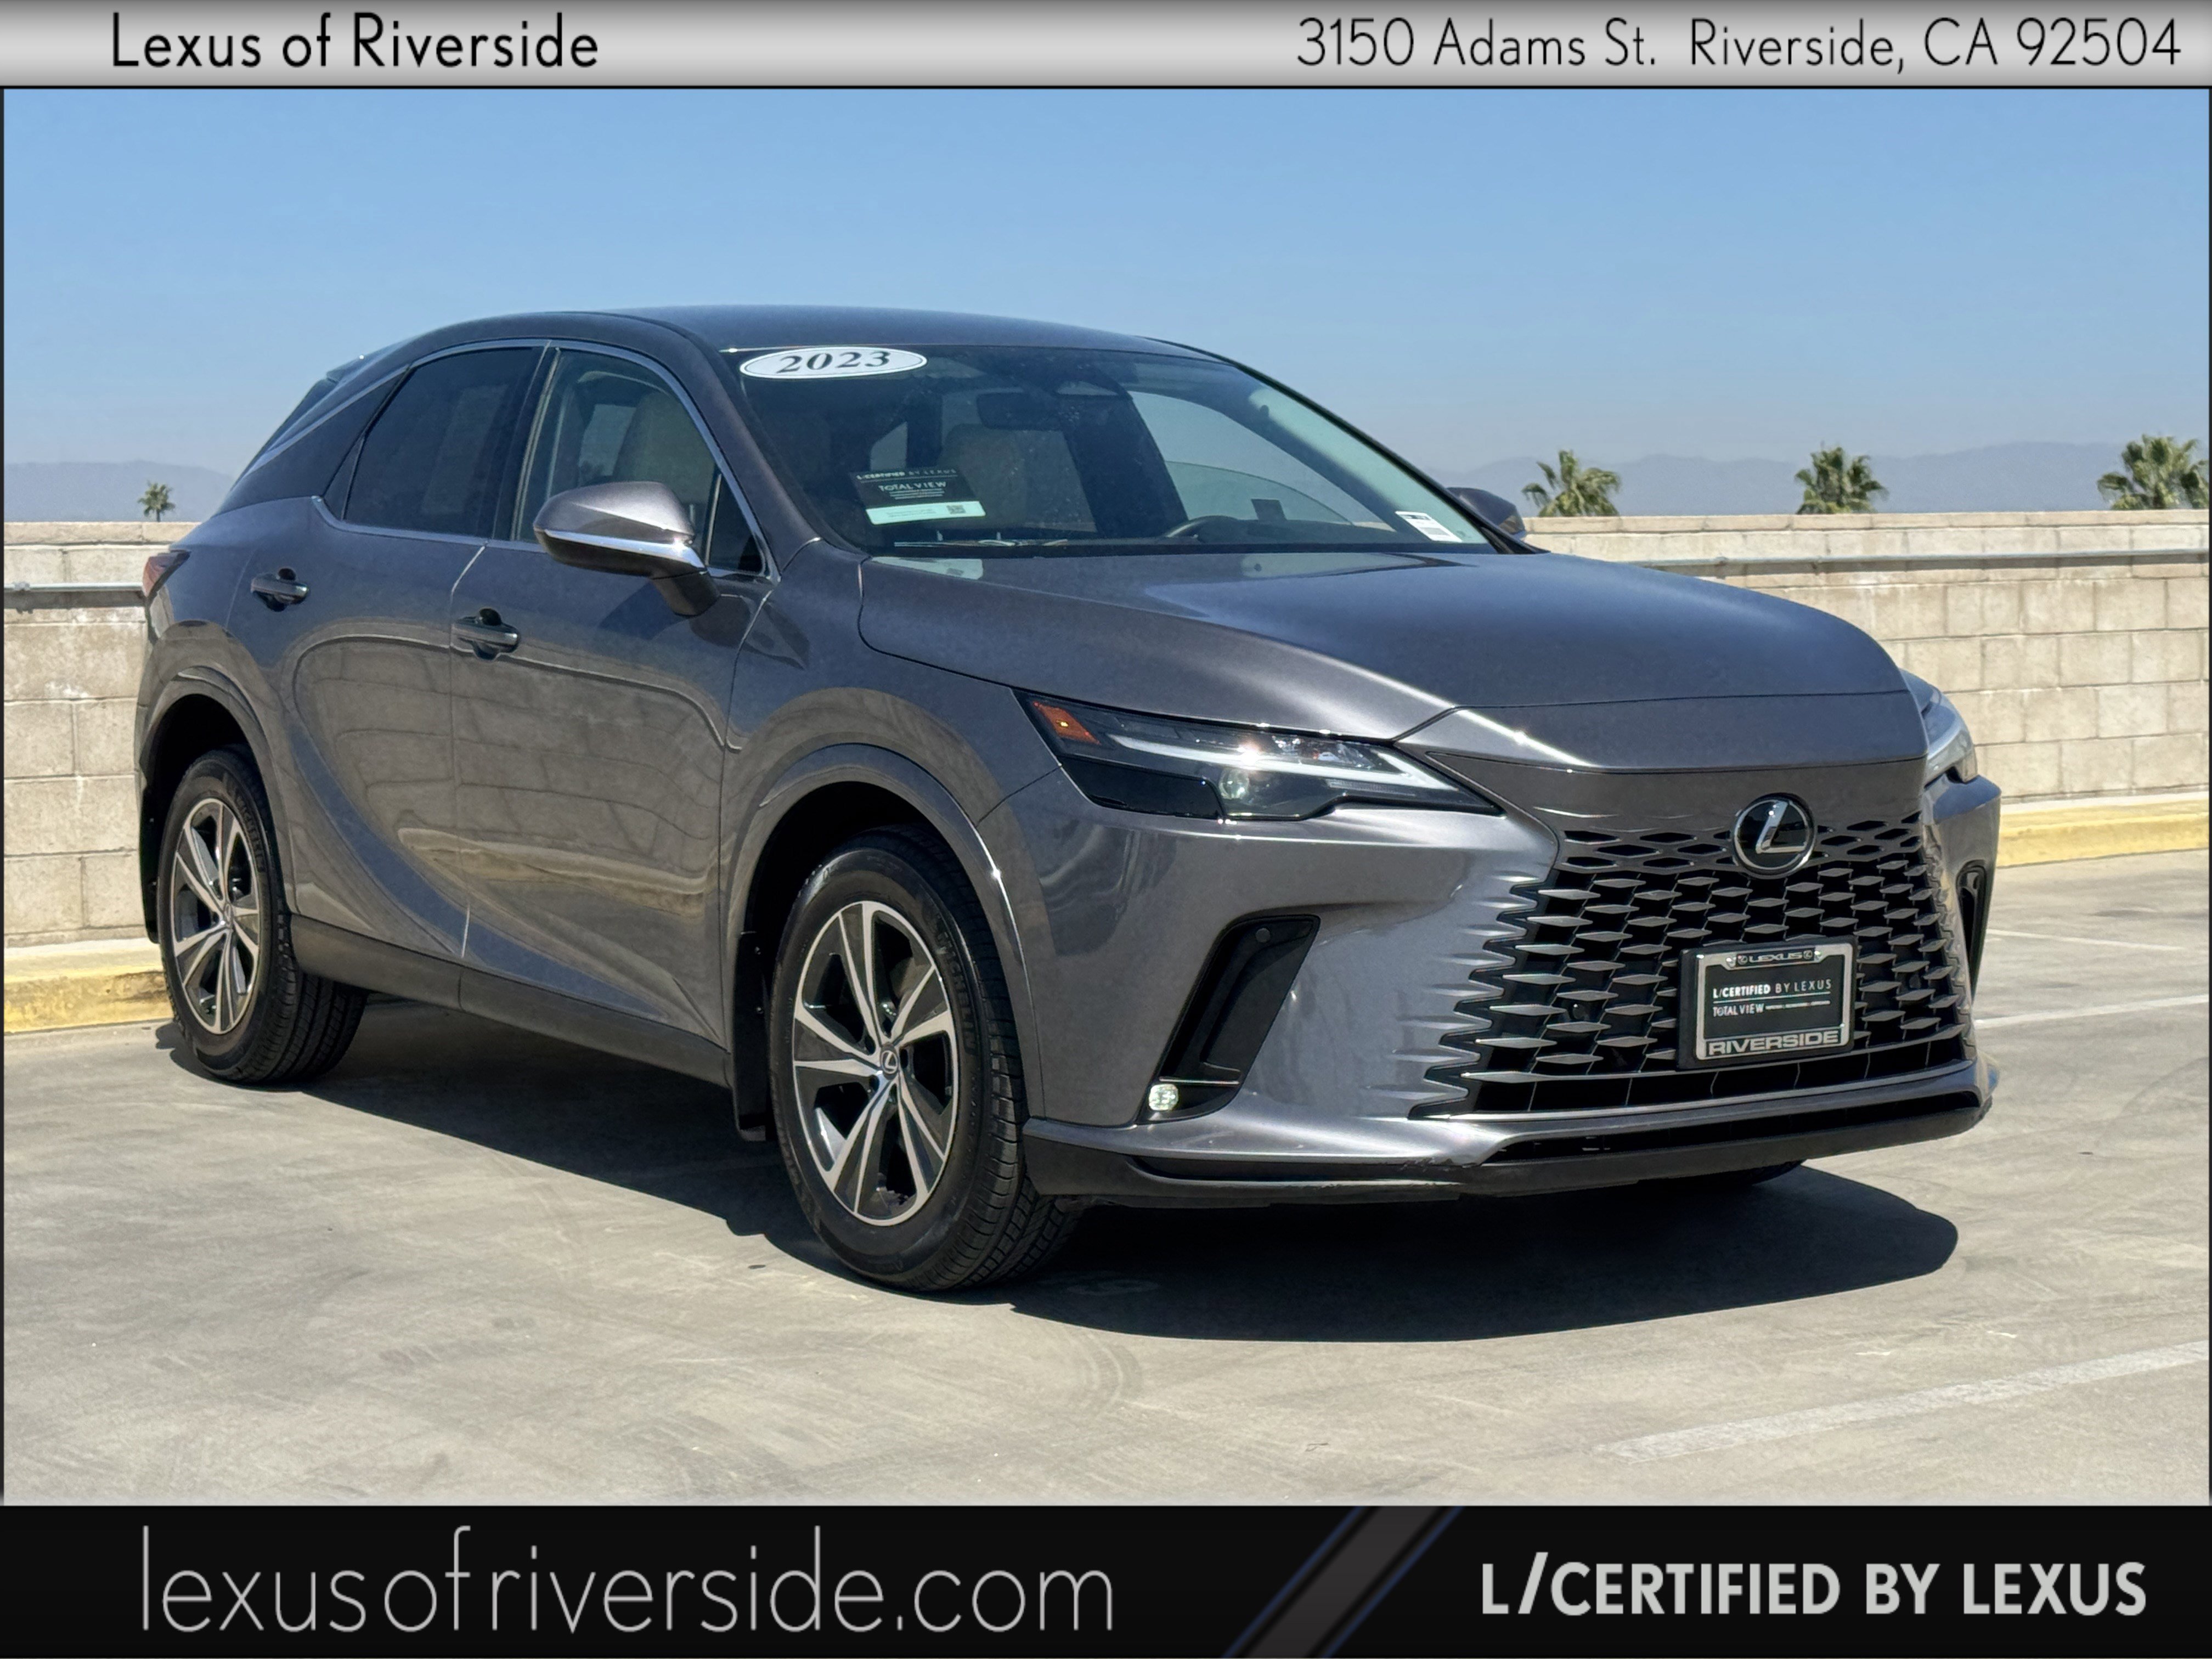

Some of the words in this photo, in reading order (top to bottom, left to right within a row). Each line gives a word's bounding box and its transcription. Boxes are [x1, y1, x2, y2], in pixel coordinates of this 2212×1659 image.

[776, 351, 890, 374] 2023
[1748, 952, 1803, 963] LEXUS
[1775, 983, 1791, 994] BY
[1794, 979, 1832, 992] LEXUS
[1712, 1005, 1739, 1018] TOTAL
[1739, 1003, 1765, 1015] VIEW
[1709, 1031, 1839, 1055] RIVERSIDE
